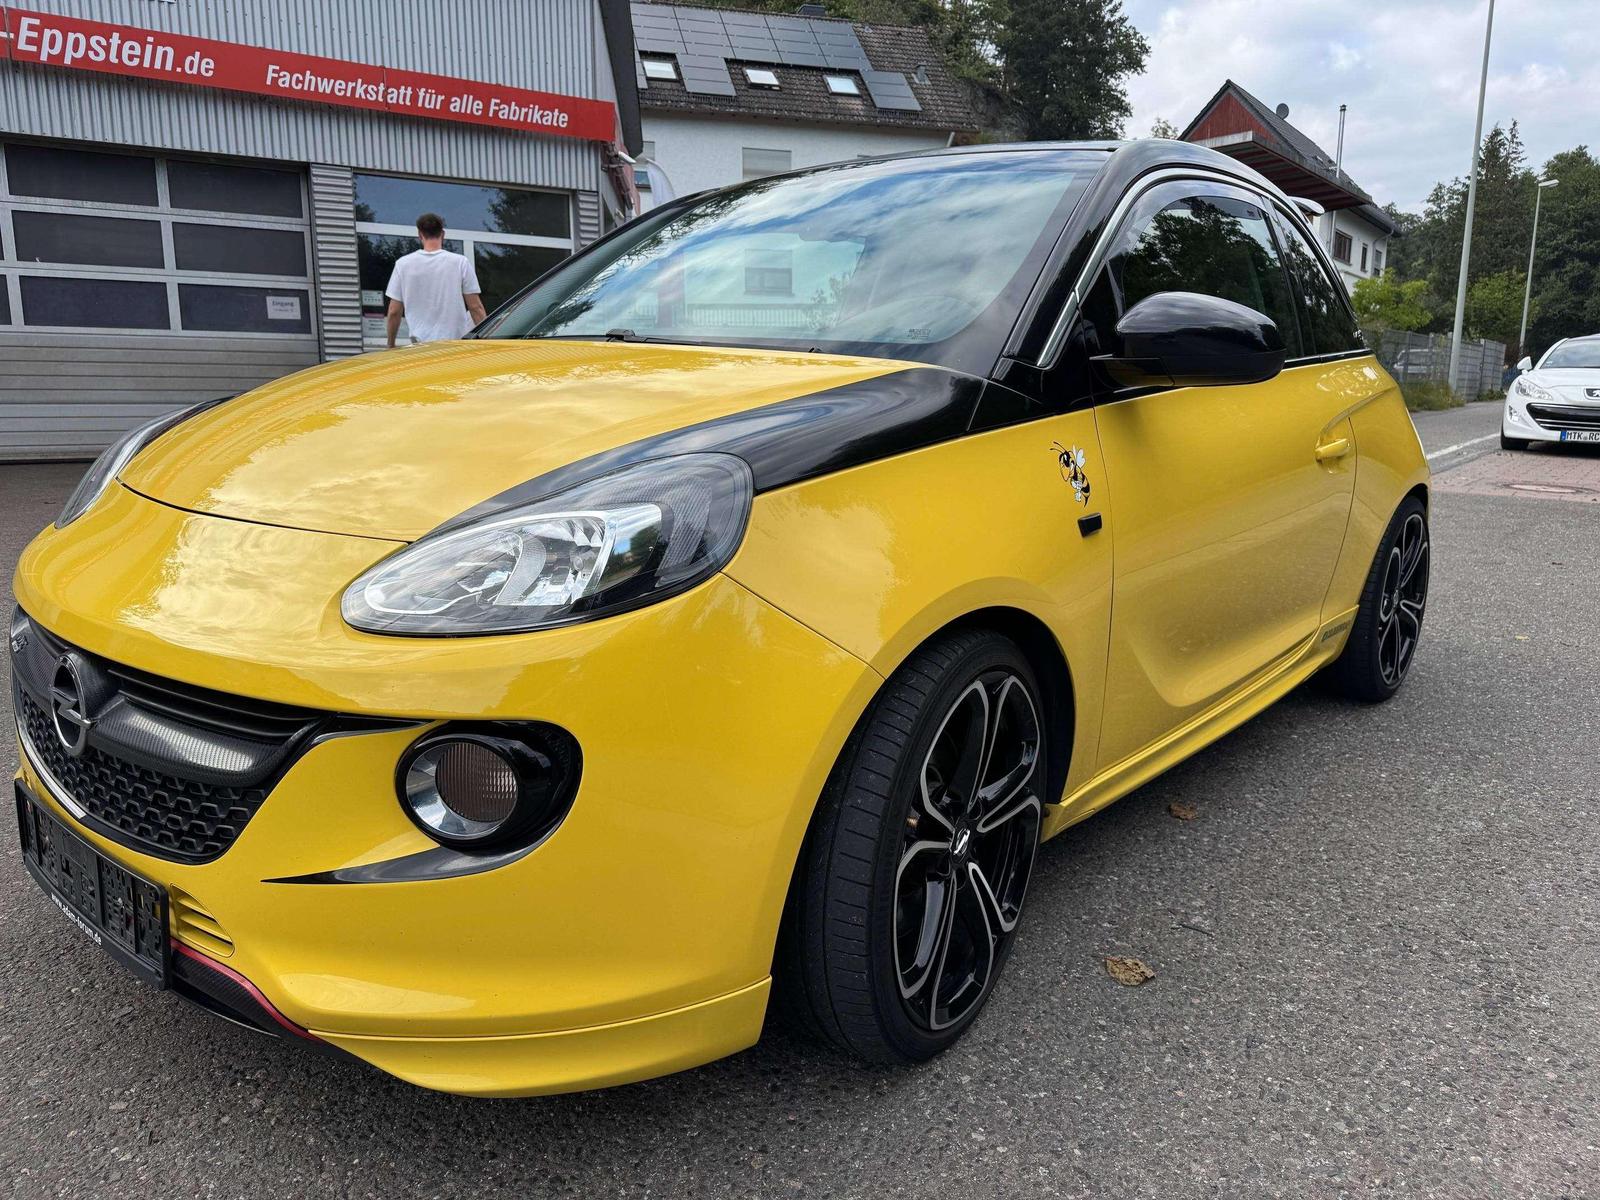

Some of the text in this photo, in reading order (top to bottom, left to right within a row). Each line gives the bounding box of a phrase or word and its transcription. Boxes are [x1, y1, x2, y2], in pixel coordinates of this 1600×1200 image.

[265, 64, 569, 129] Fachwerkstatt für alle Fabrikate
[1567, 431, 1583, 440] MTK
